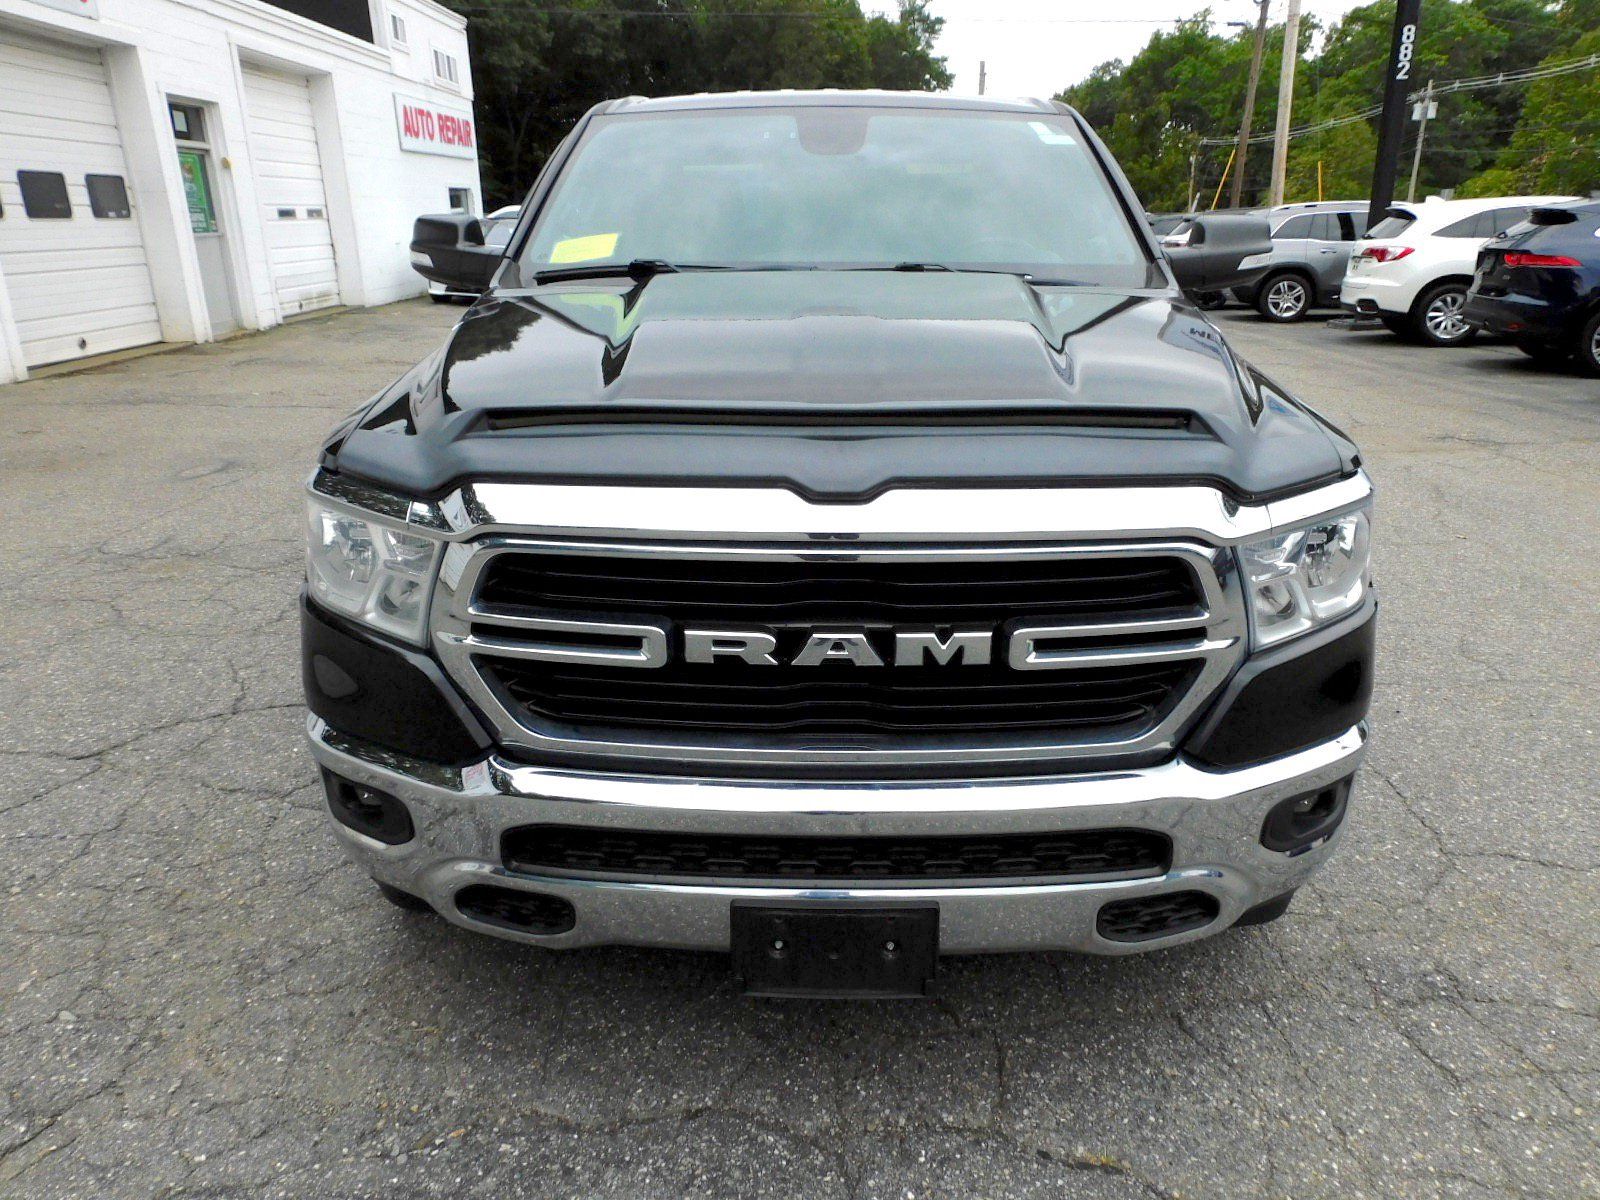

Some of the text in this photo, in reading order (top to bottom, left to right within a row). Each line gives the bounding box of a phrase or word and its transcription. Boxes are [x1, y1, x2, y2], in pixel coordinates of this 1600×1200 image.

[1395, 24, 1417, 81] 882
[403, 104, 473, 148] AUTO REPAIR
[683, 629, 993, 667] RAM
